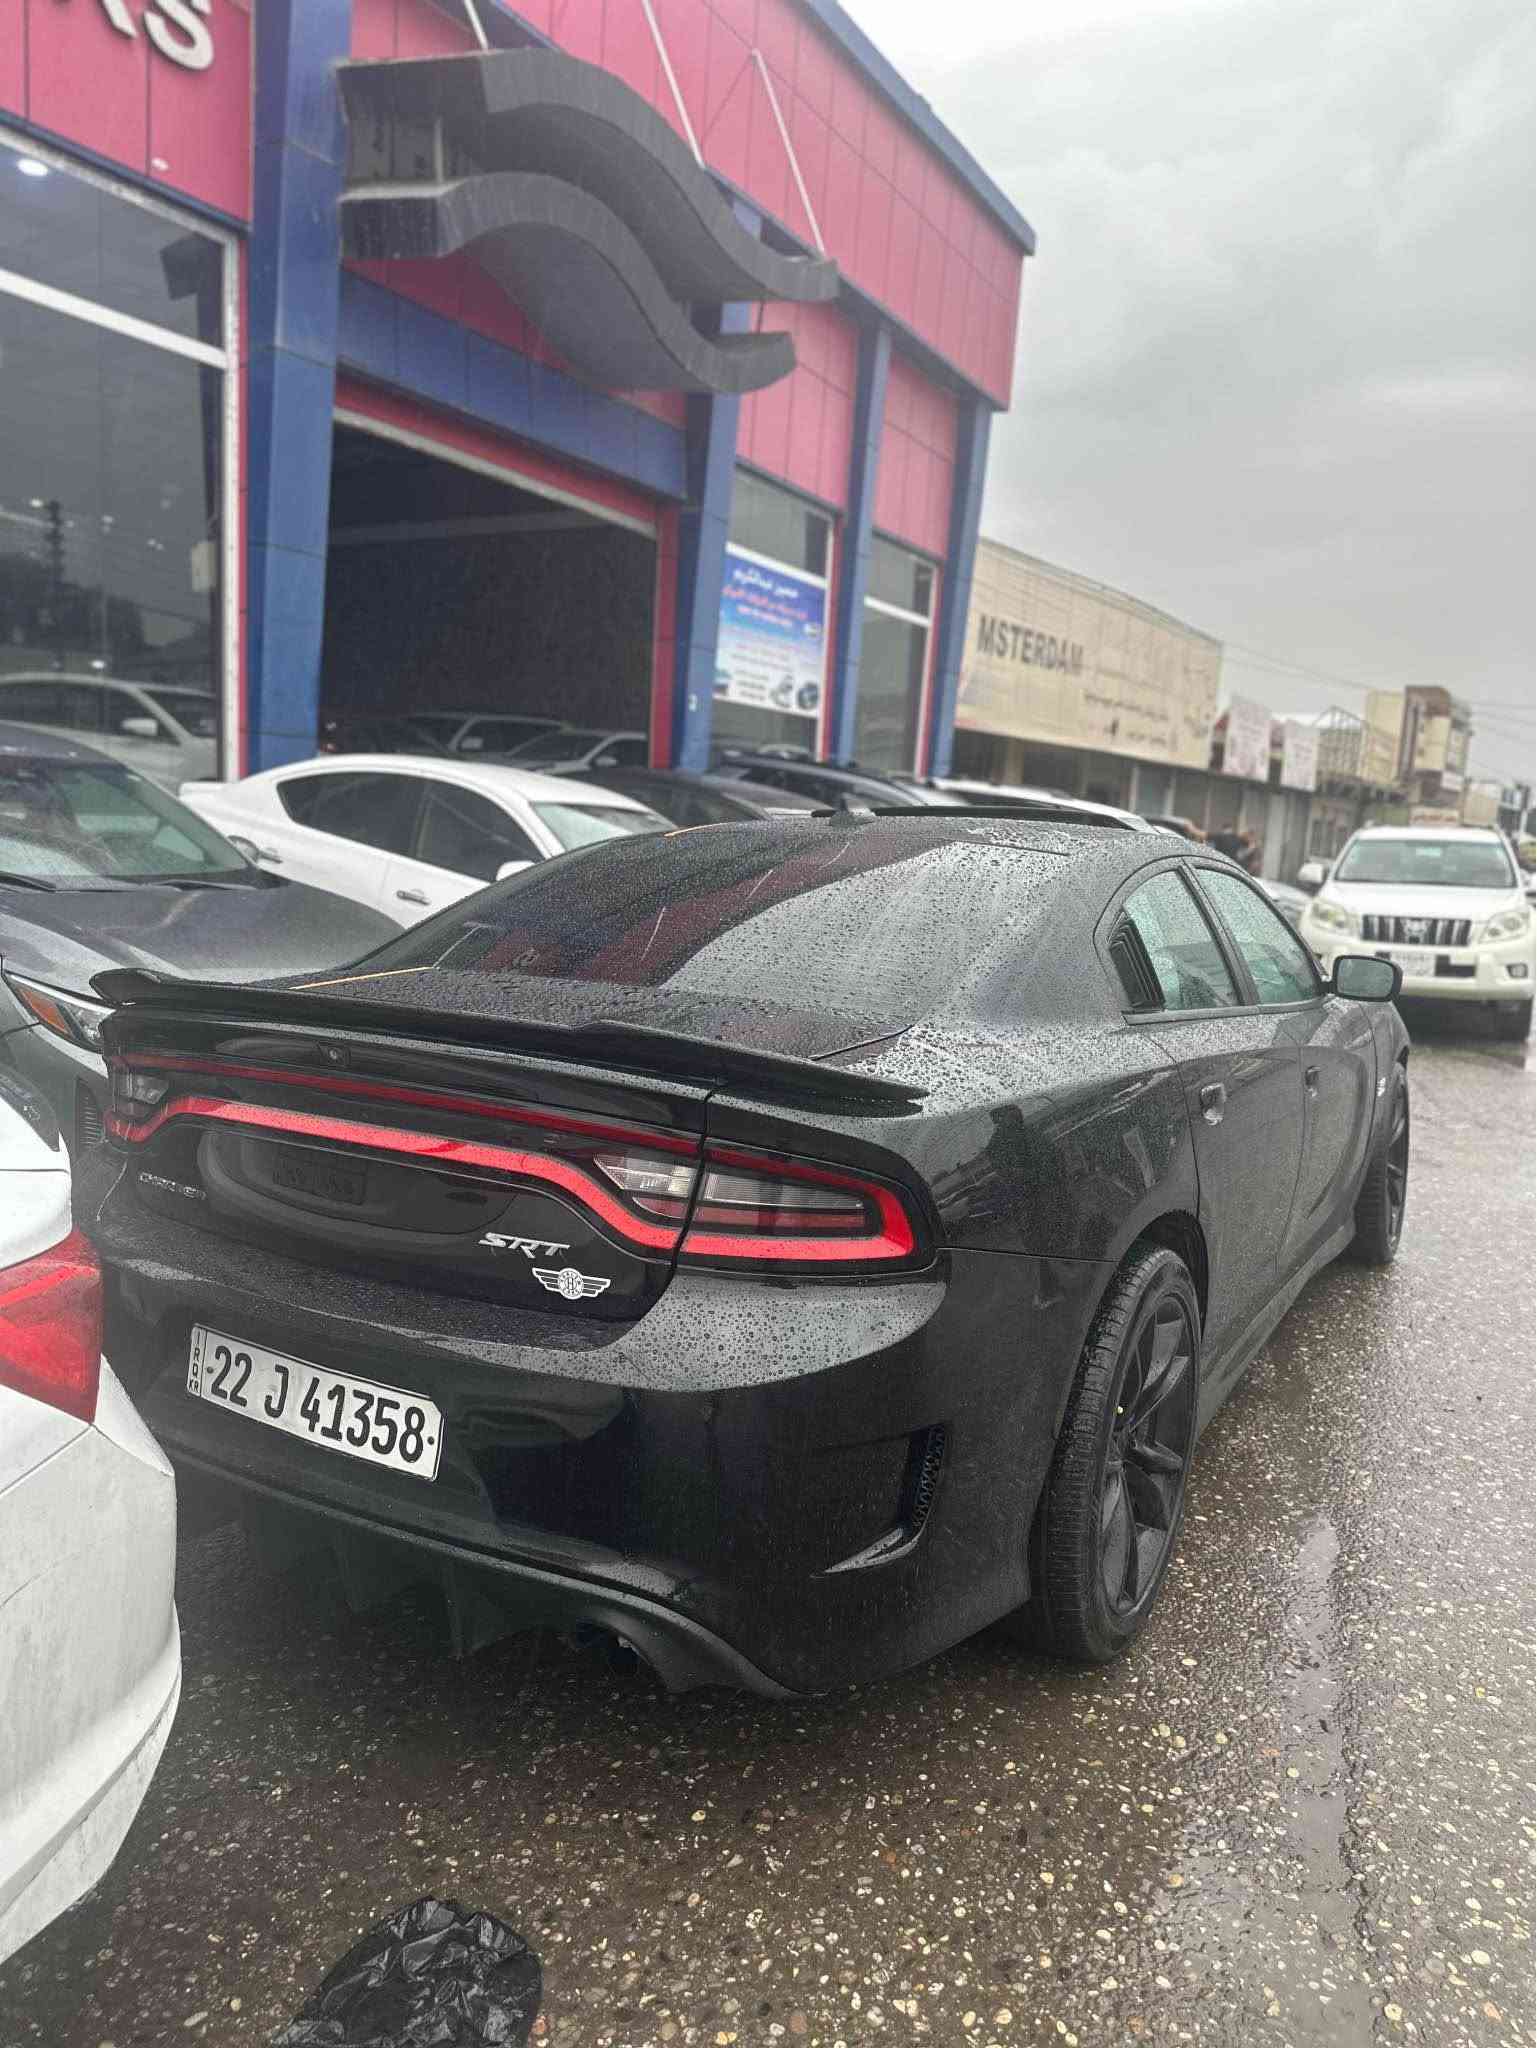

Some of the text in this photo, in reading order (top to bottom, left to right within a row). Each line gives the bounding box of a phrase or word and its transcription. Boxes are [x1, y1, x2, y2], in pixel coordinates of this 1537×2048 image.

[977, 614, 1084, 677] MSTERDAM
[478, 1231, 571, 1259] SRT
[210, 1345, 426, 1464] 22 J 41358
